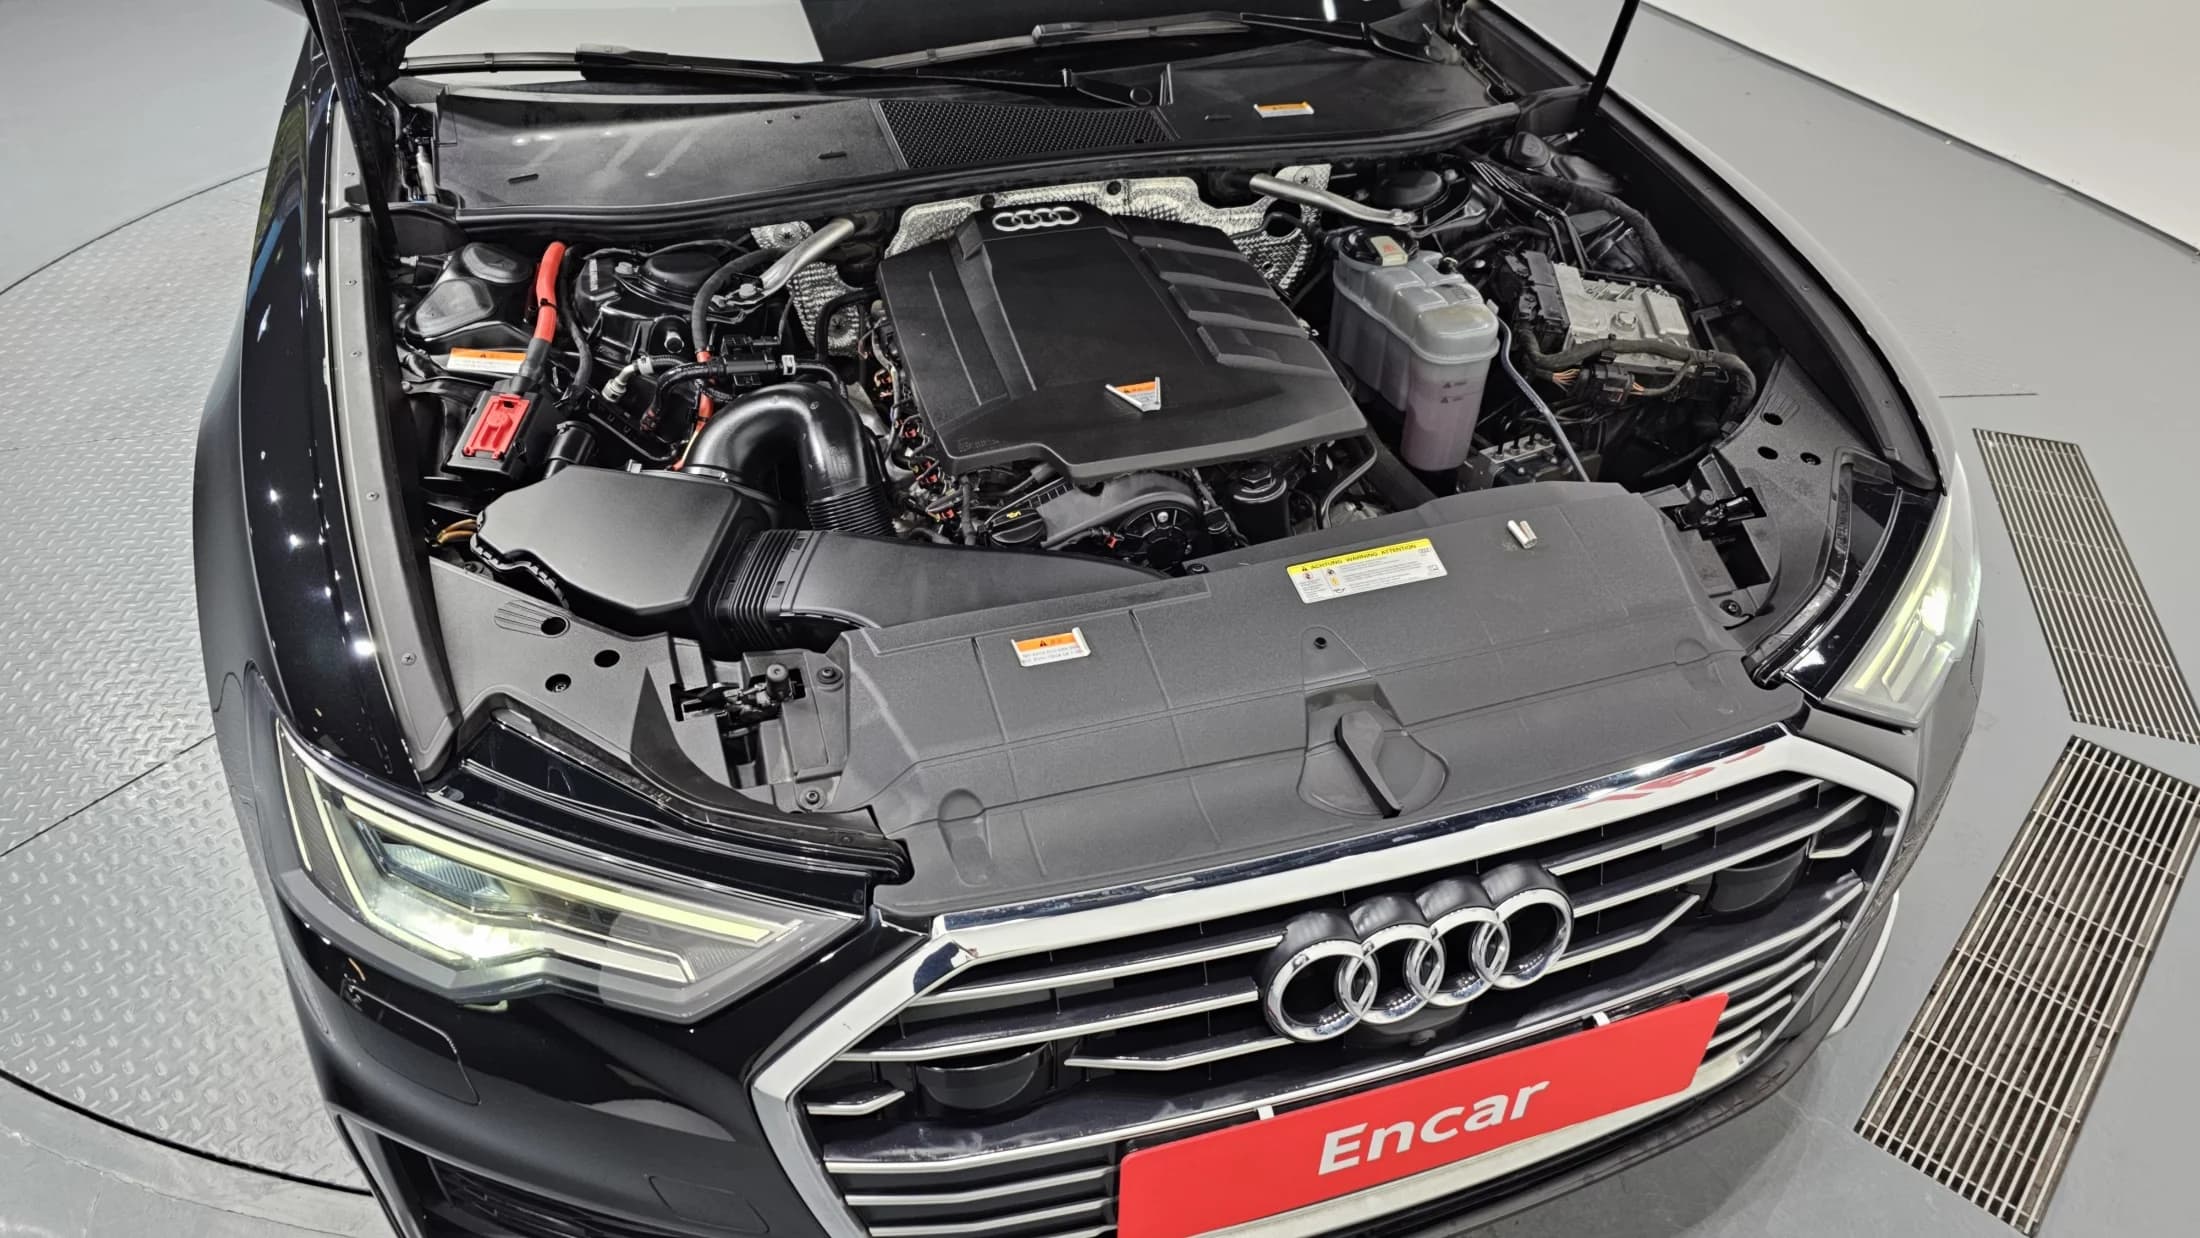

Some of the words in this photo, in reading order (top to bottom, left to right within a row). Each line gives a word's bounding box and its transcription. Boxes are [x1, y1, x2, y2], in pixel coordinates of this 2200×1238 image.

[1311, 559, 1342, 569] ACHTUNG
[1346, 552, 1378, 562] WARNING
[1381, 544, 1417, 555] ATTENTION
[1318, 1080, 1550, 1176] Encar
